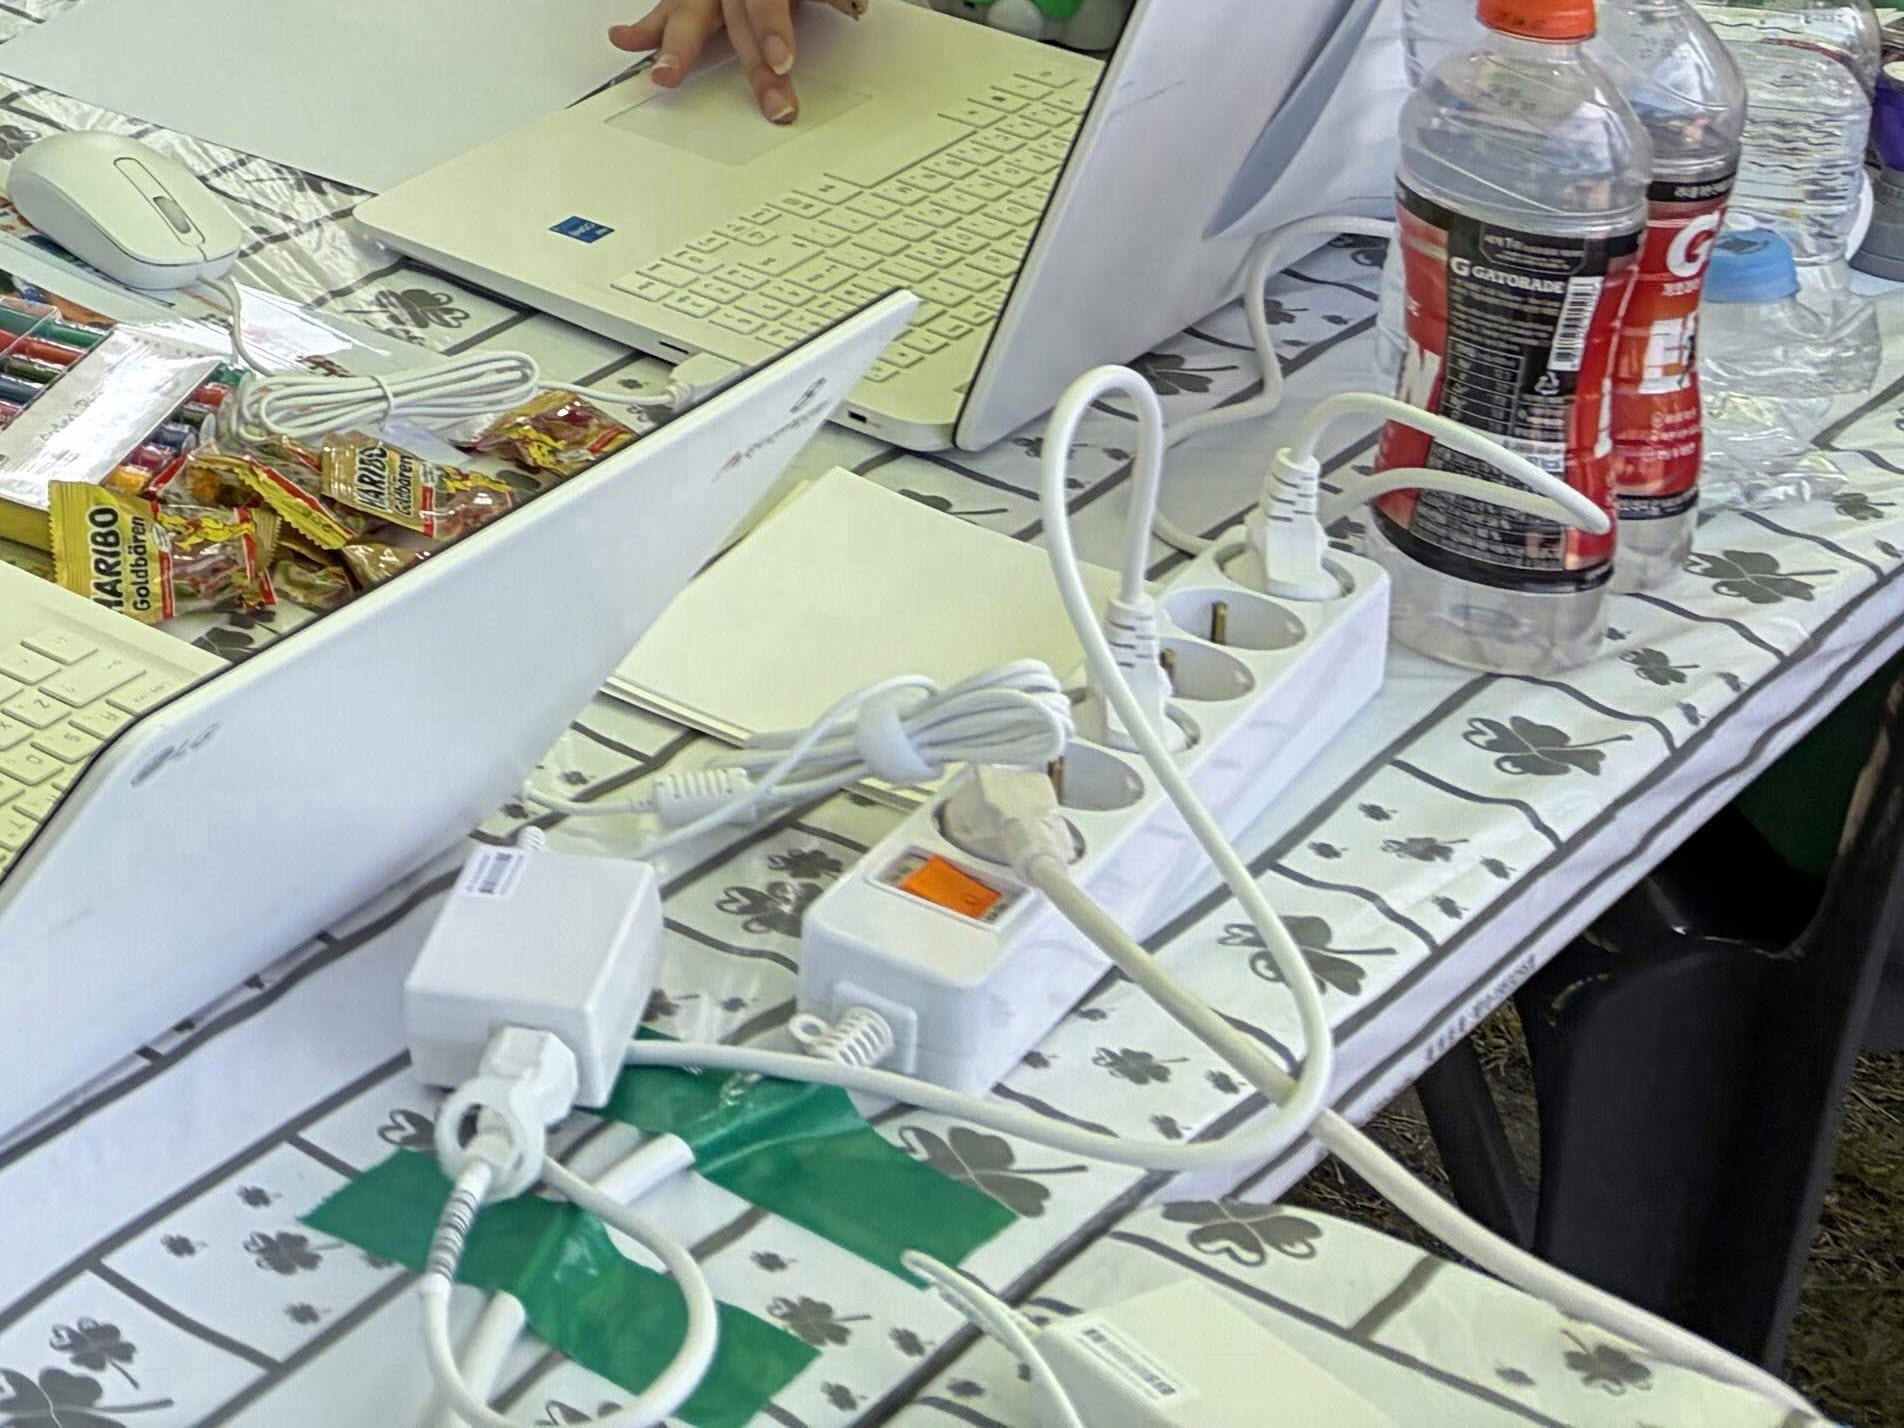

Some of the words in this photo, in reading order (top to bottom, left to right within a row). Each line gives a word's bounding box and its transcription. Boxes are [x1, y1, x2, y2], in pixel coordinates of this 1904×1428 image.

[1449, 256, 1471, 277] G
[1471, 266, 1566, 295] GATORADE
[356, 443, 389, 512] HARIBO
[132, 514, 147, 612] Goldbären
